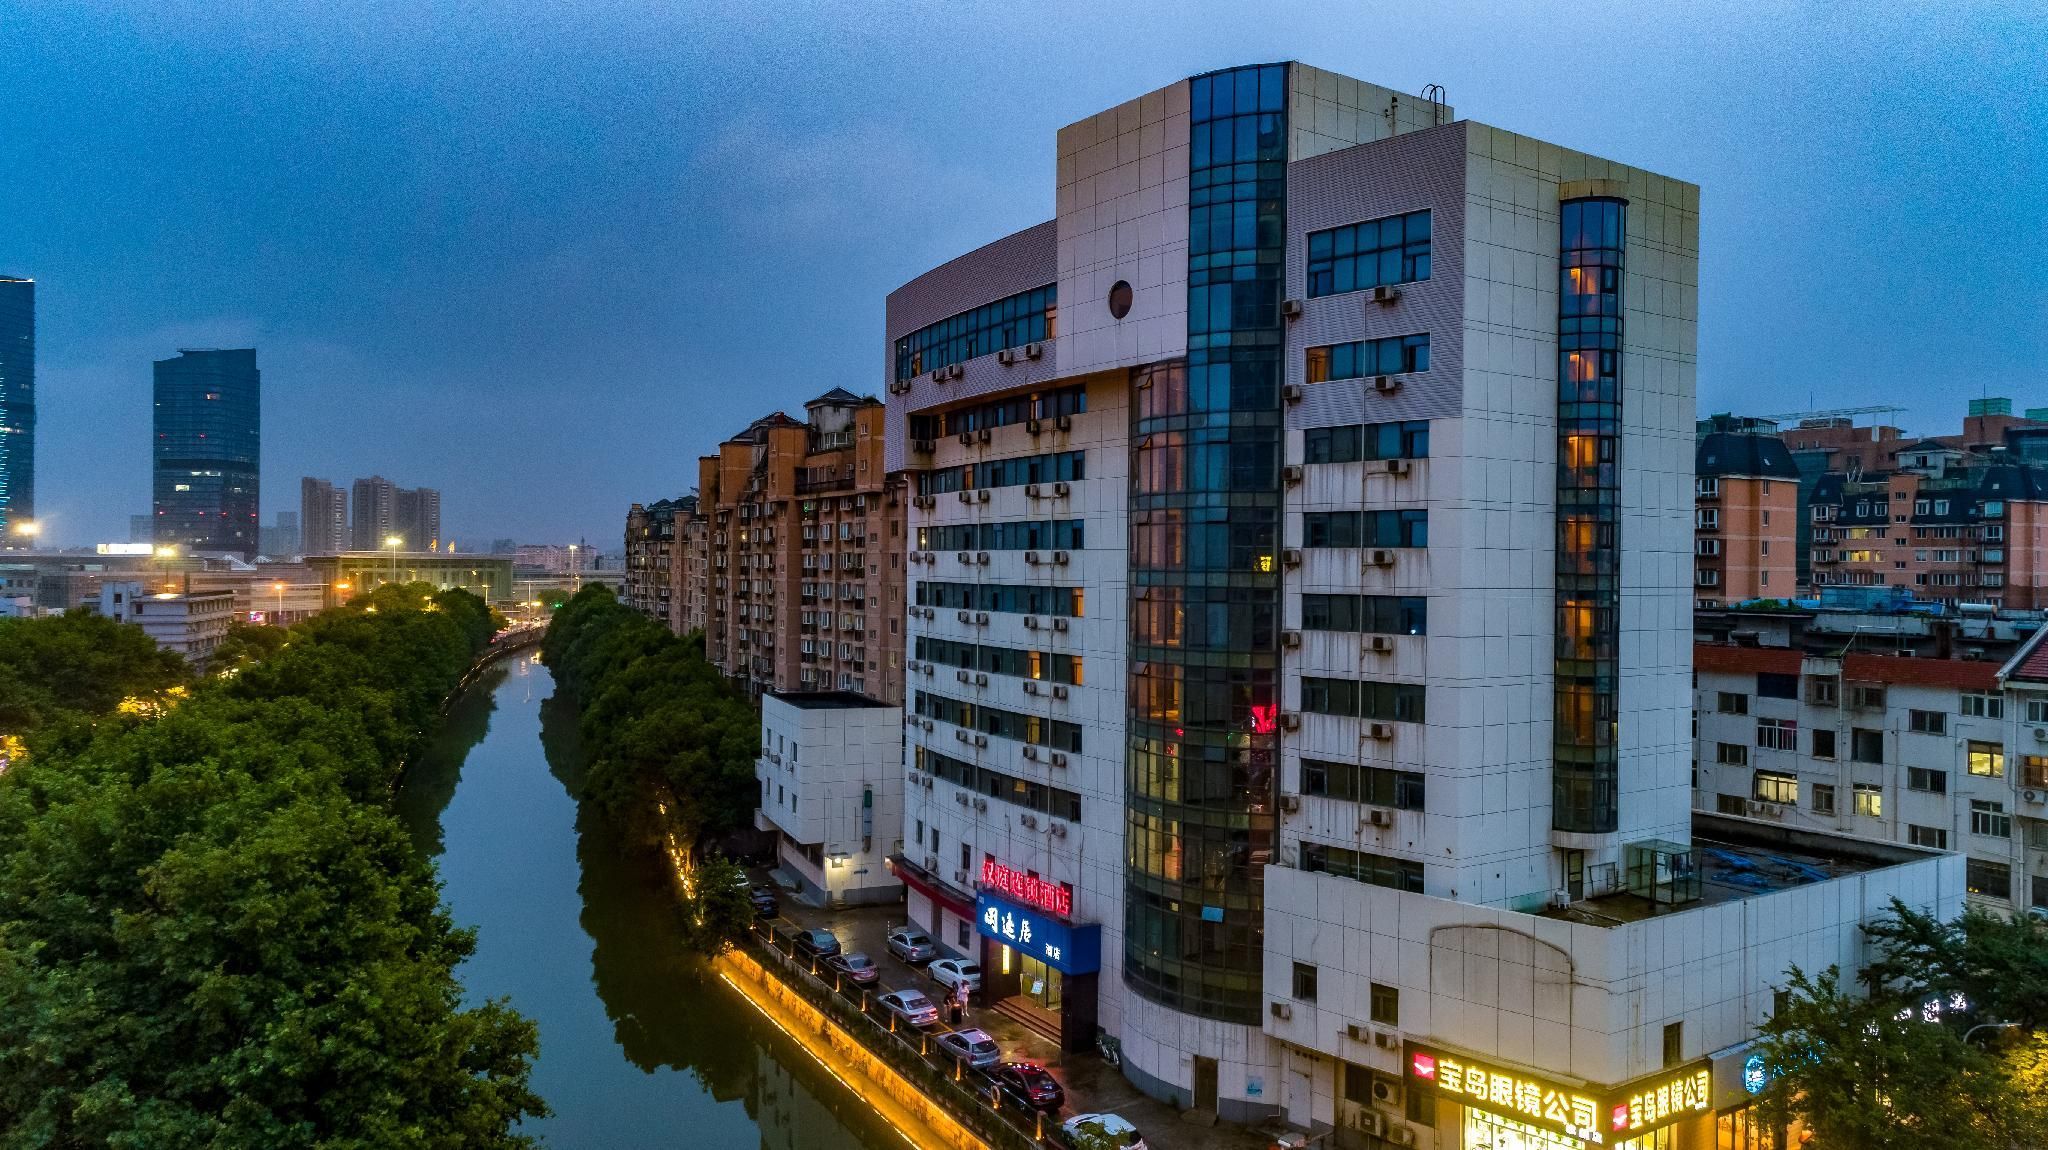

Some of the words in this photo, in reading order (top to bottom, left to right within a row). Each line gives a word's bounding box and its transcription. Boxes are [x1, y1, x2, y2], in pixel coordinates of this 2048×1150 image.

[982, 860, 1070, 915] 汉庭连锁酒店
[1045, 943, 1060, 960] 酒店
[1438, 1058, 1597, 1132] 宝岛眼镜公司
[1629, 1070, 1709, 1130] 宝岛眼镜公司
